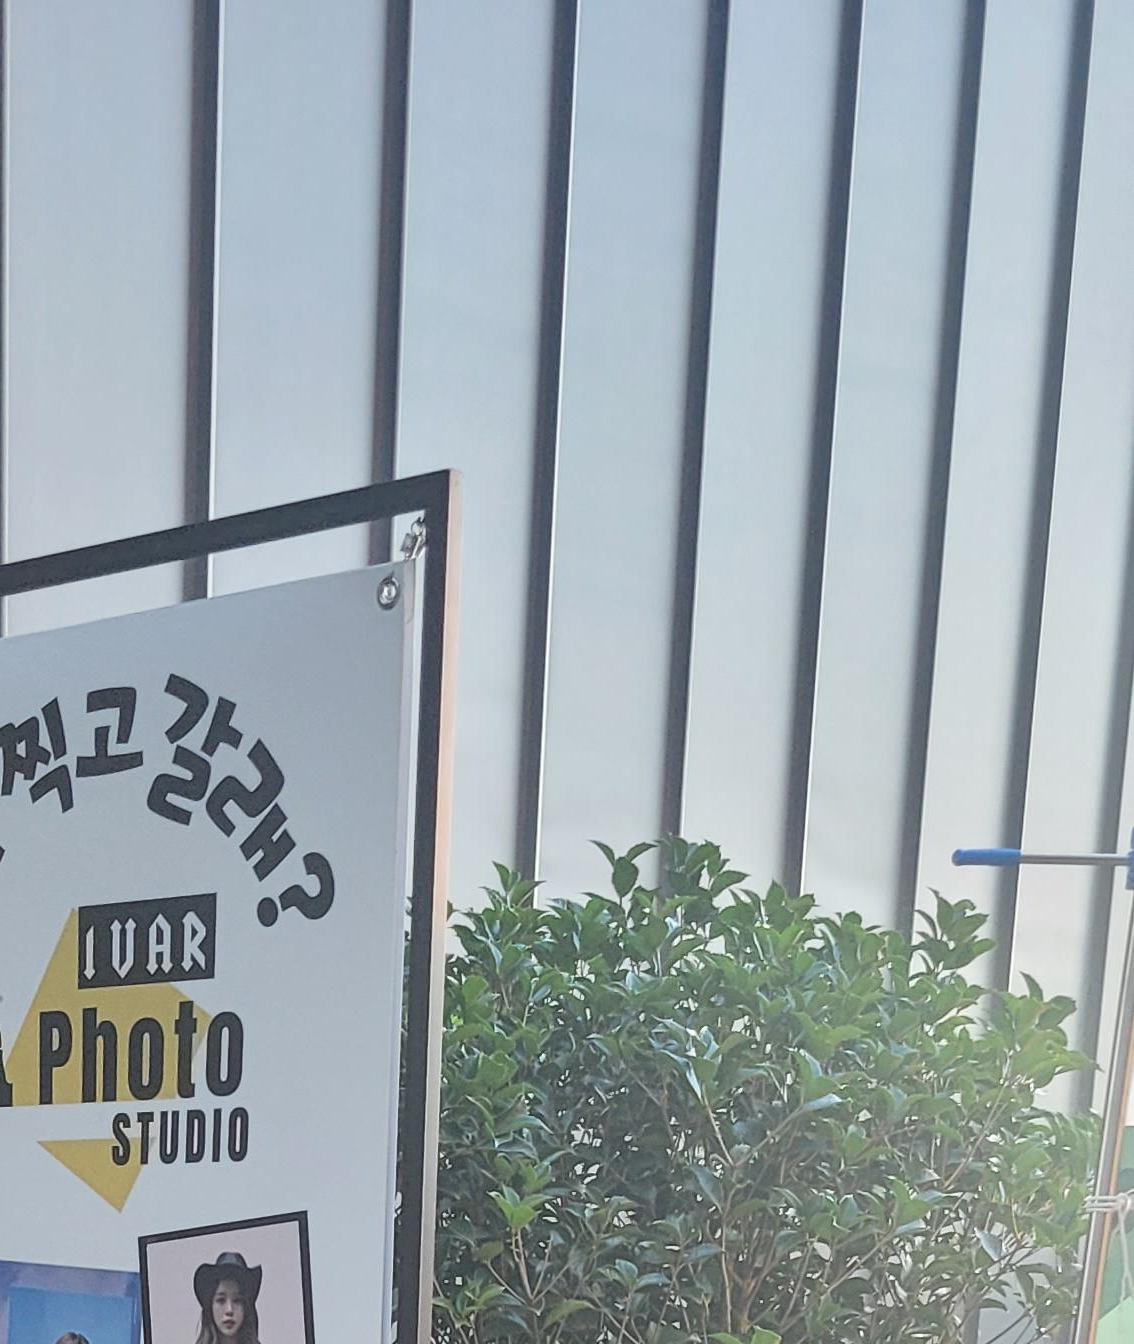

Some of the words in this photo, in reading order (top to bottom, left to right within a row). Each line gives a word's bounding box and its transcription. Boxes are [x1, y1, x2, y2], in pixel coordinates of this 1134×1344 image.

[146, 673, 336, 928] 갈래?
[81, 909, 208, 982] IVAR
[38, 1000, 245, 1106] Photo
[111, 1106, 249, 1167] STUDIO
